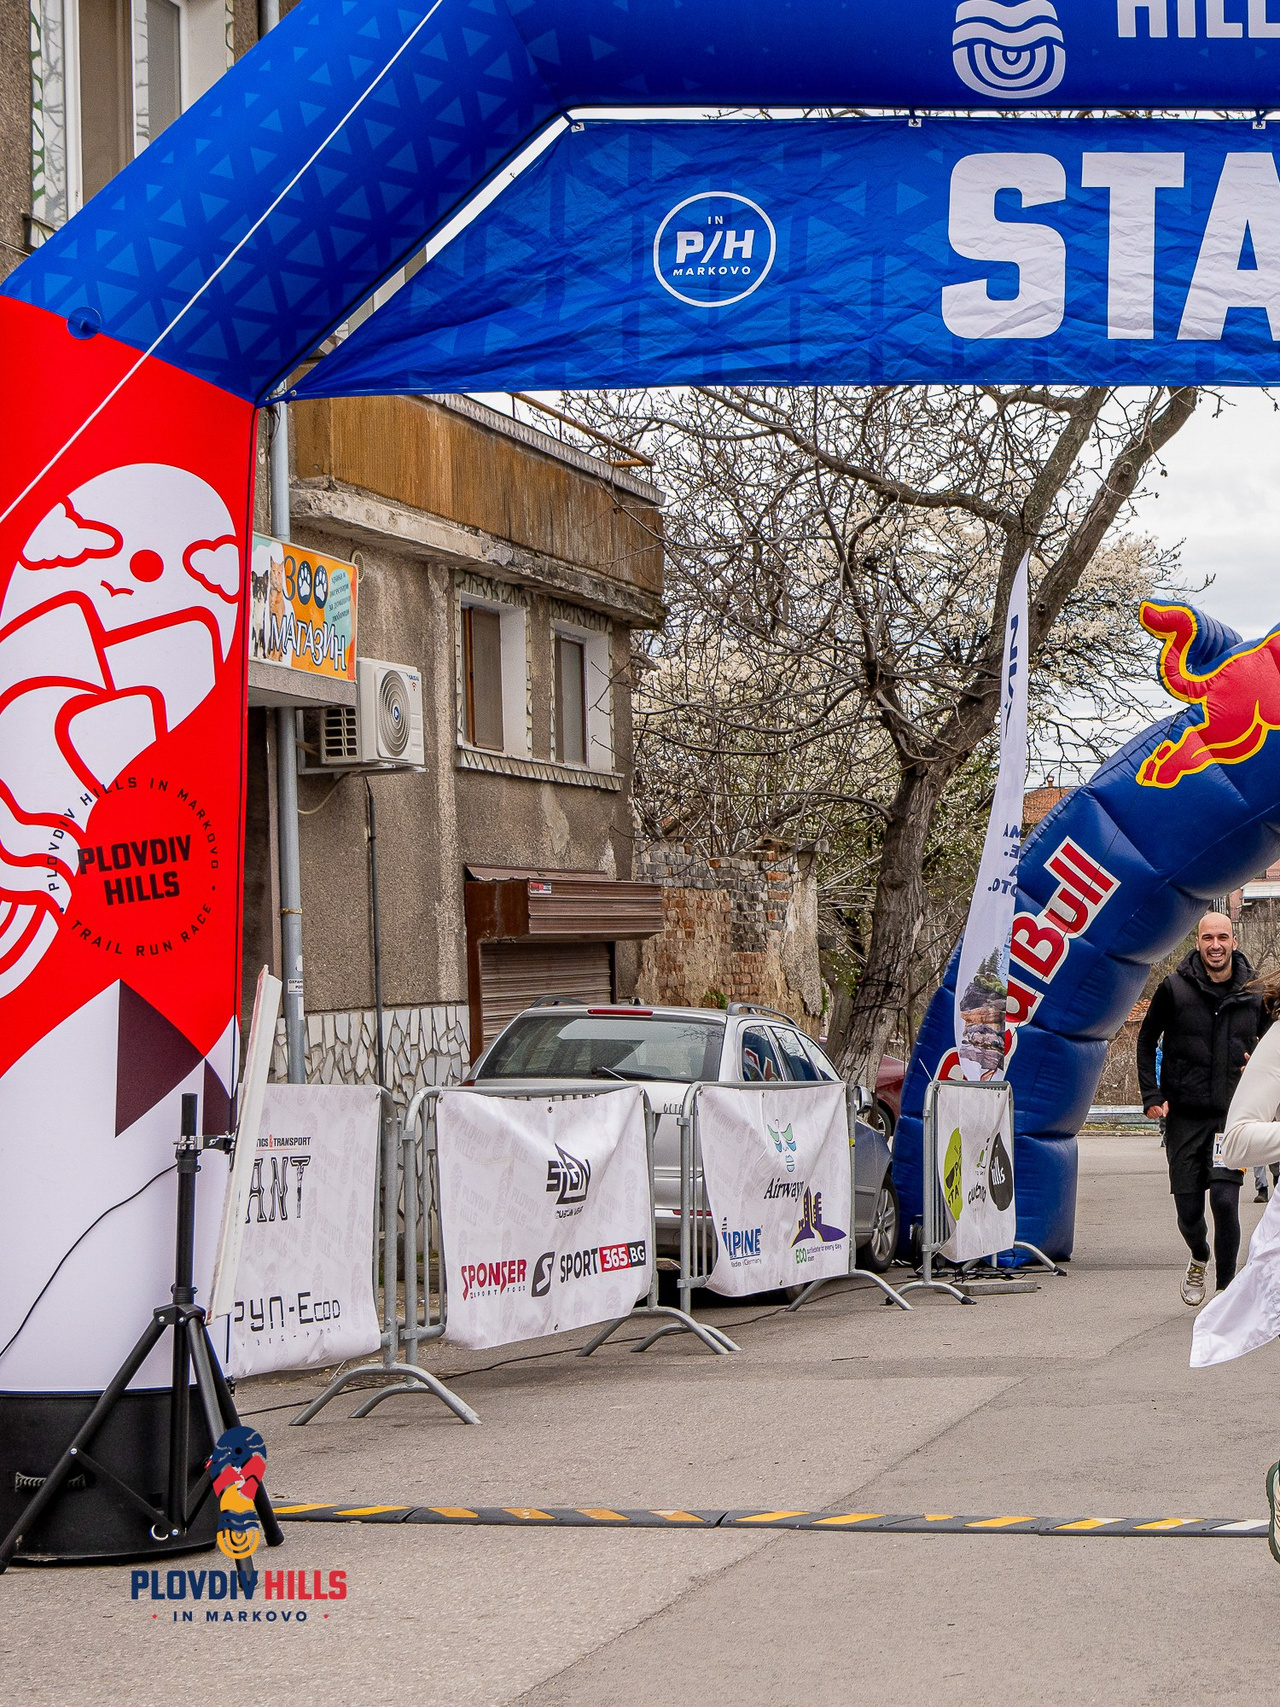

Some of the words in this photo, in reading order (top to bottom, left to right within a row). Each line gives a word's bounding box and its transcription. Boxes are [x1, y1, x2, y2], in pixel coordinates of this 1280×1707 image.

[707, 215, 724, 225] IN
[675, 229, 755, 264] P/H
[672, 266, 751, 276] MARKOVO
[270, 611, 346, 671] МАГАЗИН
[47, 808, 76, 891] PLOVDIV
[80, 777, 137, 806] HILLS
[150, 778, 169, 791] IN
[177, 789, 219, 869] MARKOVO
[77, 834, 191, 875] PLOVDIV
[104, 871, 181, 906] HILLS
[71, 919, 123, 955] TRAIL
[136, 940, 173, 956] RUN
[180, 903, 212, 943] RACE
[1010, 842, 1114, 978] Bull
[274, 1137, 311, 1147] TRANSPORT
[461, 1259, 527, 1301] SPONSER
